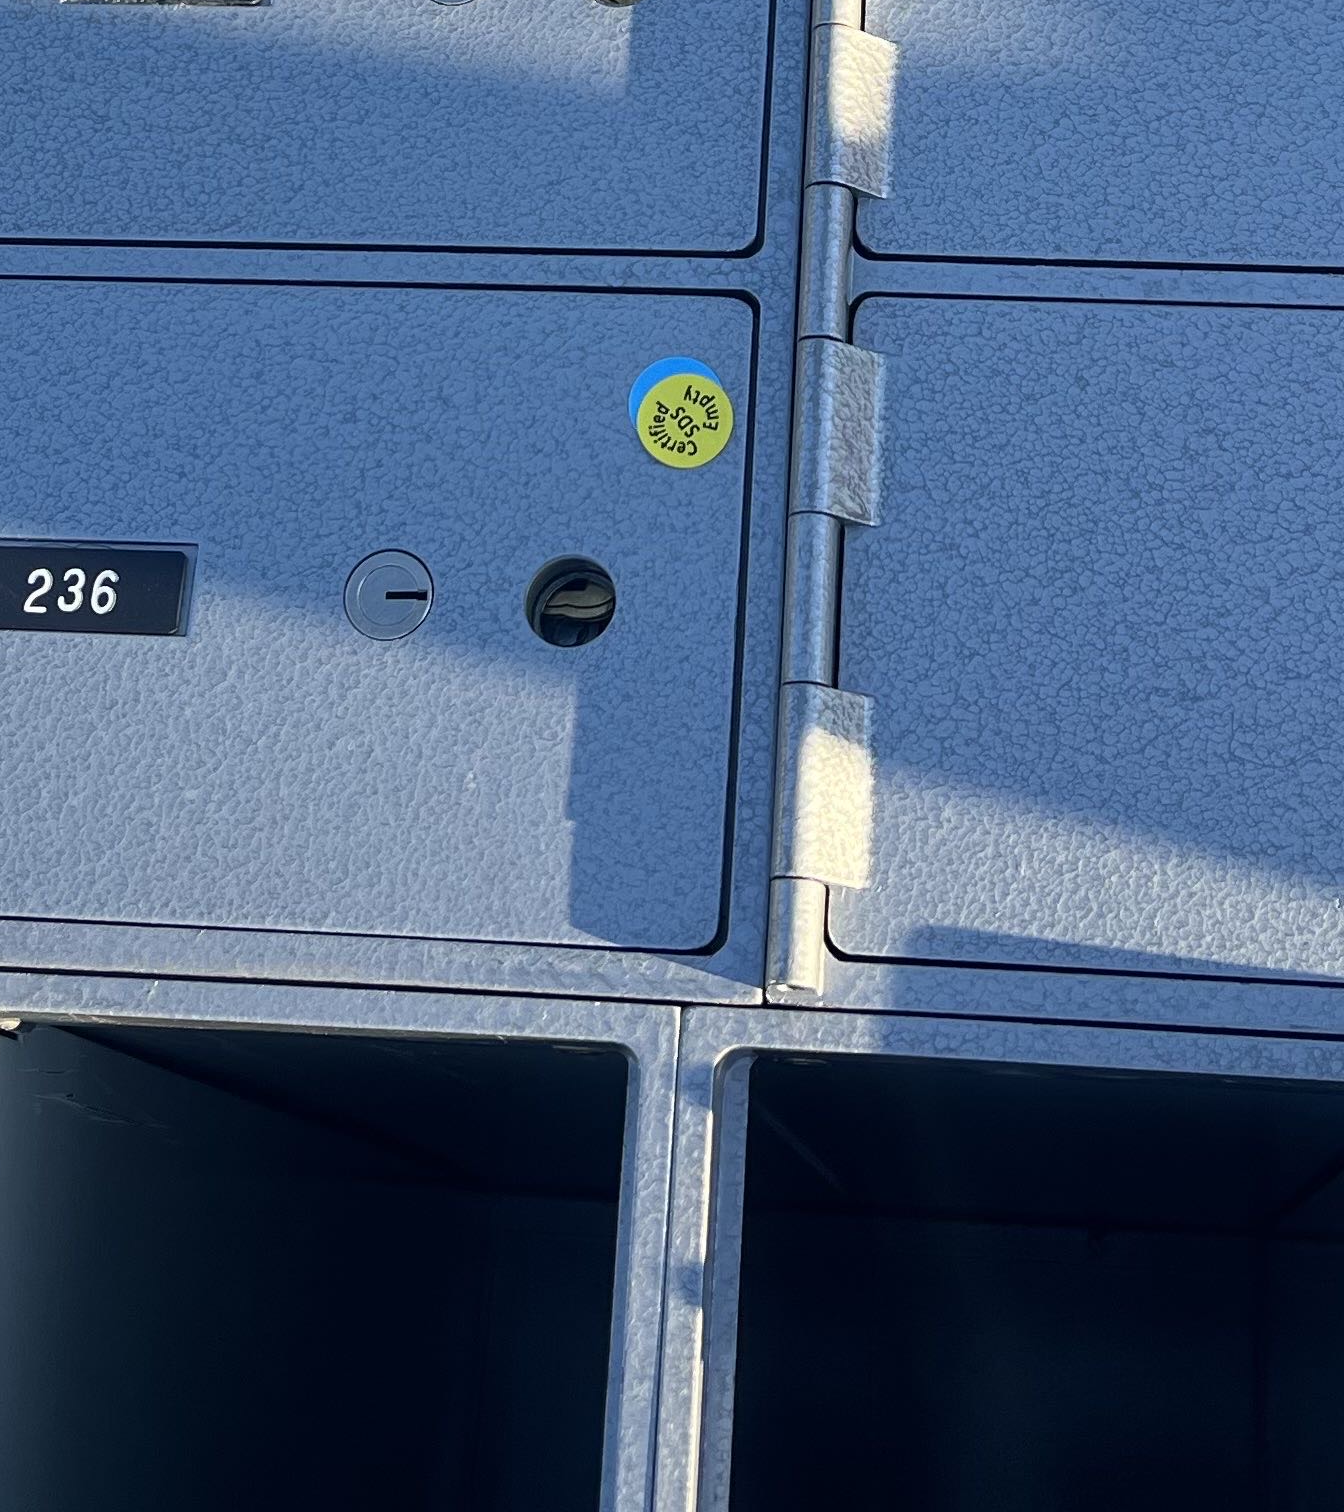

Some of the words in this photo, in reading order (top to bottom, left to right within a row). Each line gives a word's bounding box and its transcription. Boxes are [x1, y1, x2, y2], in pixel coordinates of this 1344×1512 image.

[648, 401, 698, 456] Certified
[670, 407, 700, 438] SDS
[684, 385, 719, 431] Empty
[22, 568, 119, 614] 236
